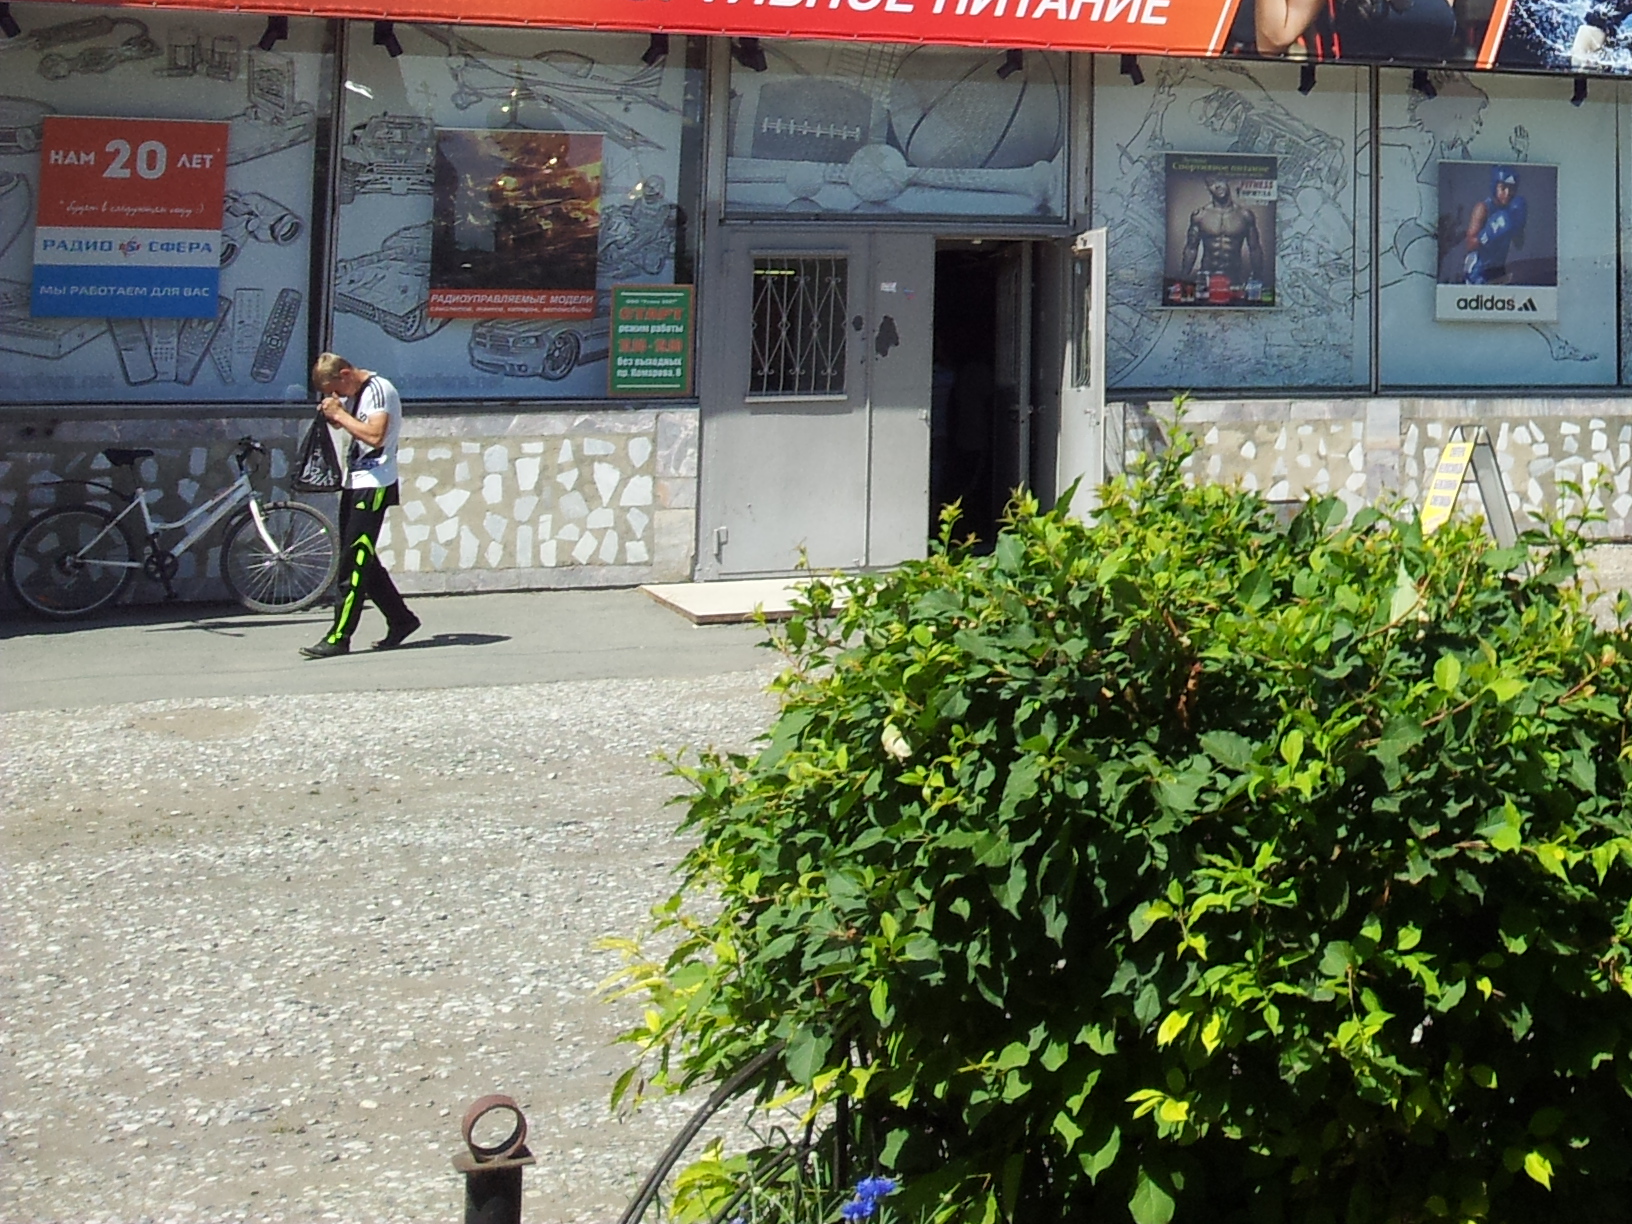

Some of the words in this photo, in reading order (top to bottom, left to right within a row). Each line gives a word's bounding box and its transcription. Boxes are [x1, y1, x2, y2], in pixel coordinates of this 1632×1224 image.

[49, 149, 97, 165] НАМ
[102, 138, 168, 180] 20
[177, 153, 214, 169] ЛЕТ
[42, 238, 114, 253] РАДИО
[148, 240, 213, 254] СФЕРА
[39, 285, 67, 296] МЫ
[70, 285, 148, 298] РАБОТАЕМ
[150, 286, 181, 298] ДЛЯ
[183, 287, 211, 298] ВАС
[430, 294, 547, 305] РАДИОУПРАВЛЯЕМЫЕ
[549, 295, 594, 305] МОДЕЛИ
[1456, 294, 1516, 311] adidas
